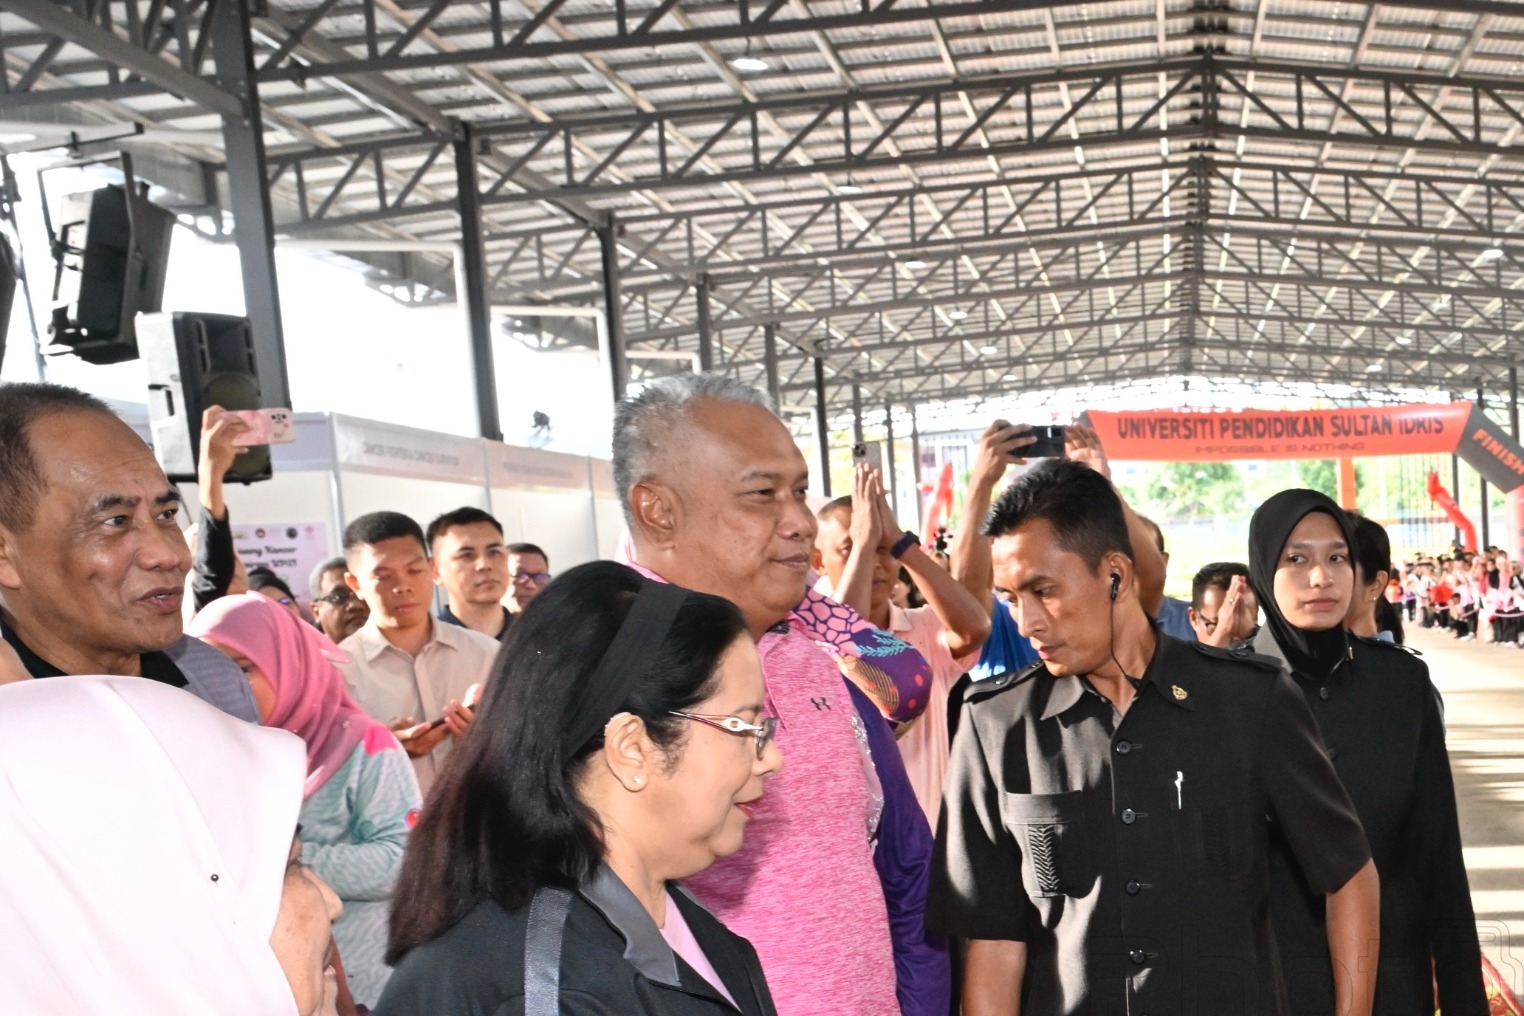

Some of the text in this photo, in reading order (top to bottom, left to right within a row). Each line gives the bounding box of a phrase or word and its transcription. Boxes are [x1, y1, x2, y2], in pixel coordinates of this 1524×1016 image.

[1117, 413, 1443, 440] UNIVERSITI PENDIDIKAN SULTAN IDRIS
[1302, 441, 1365, 452] NOTHING
